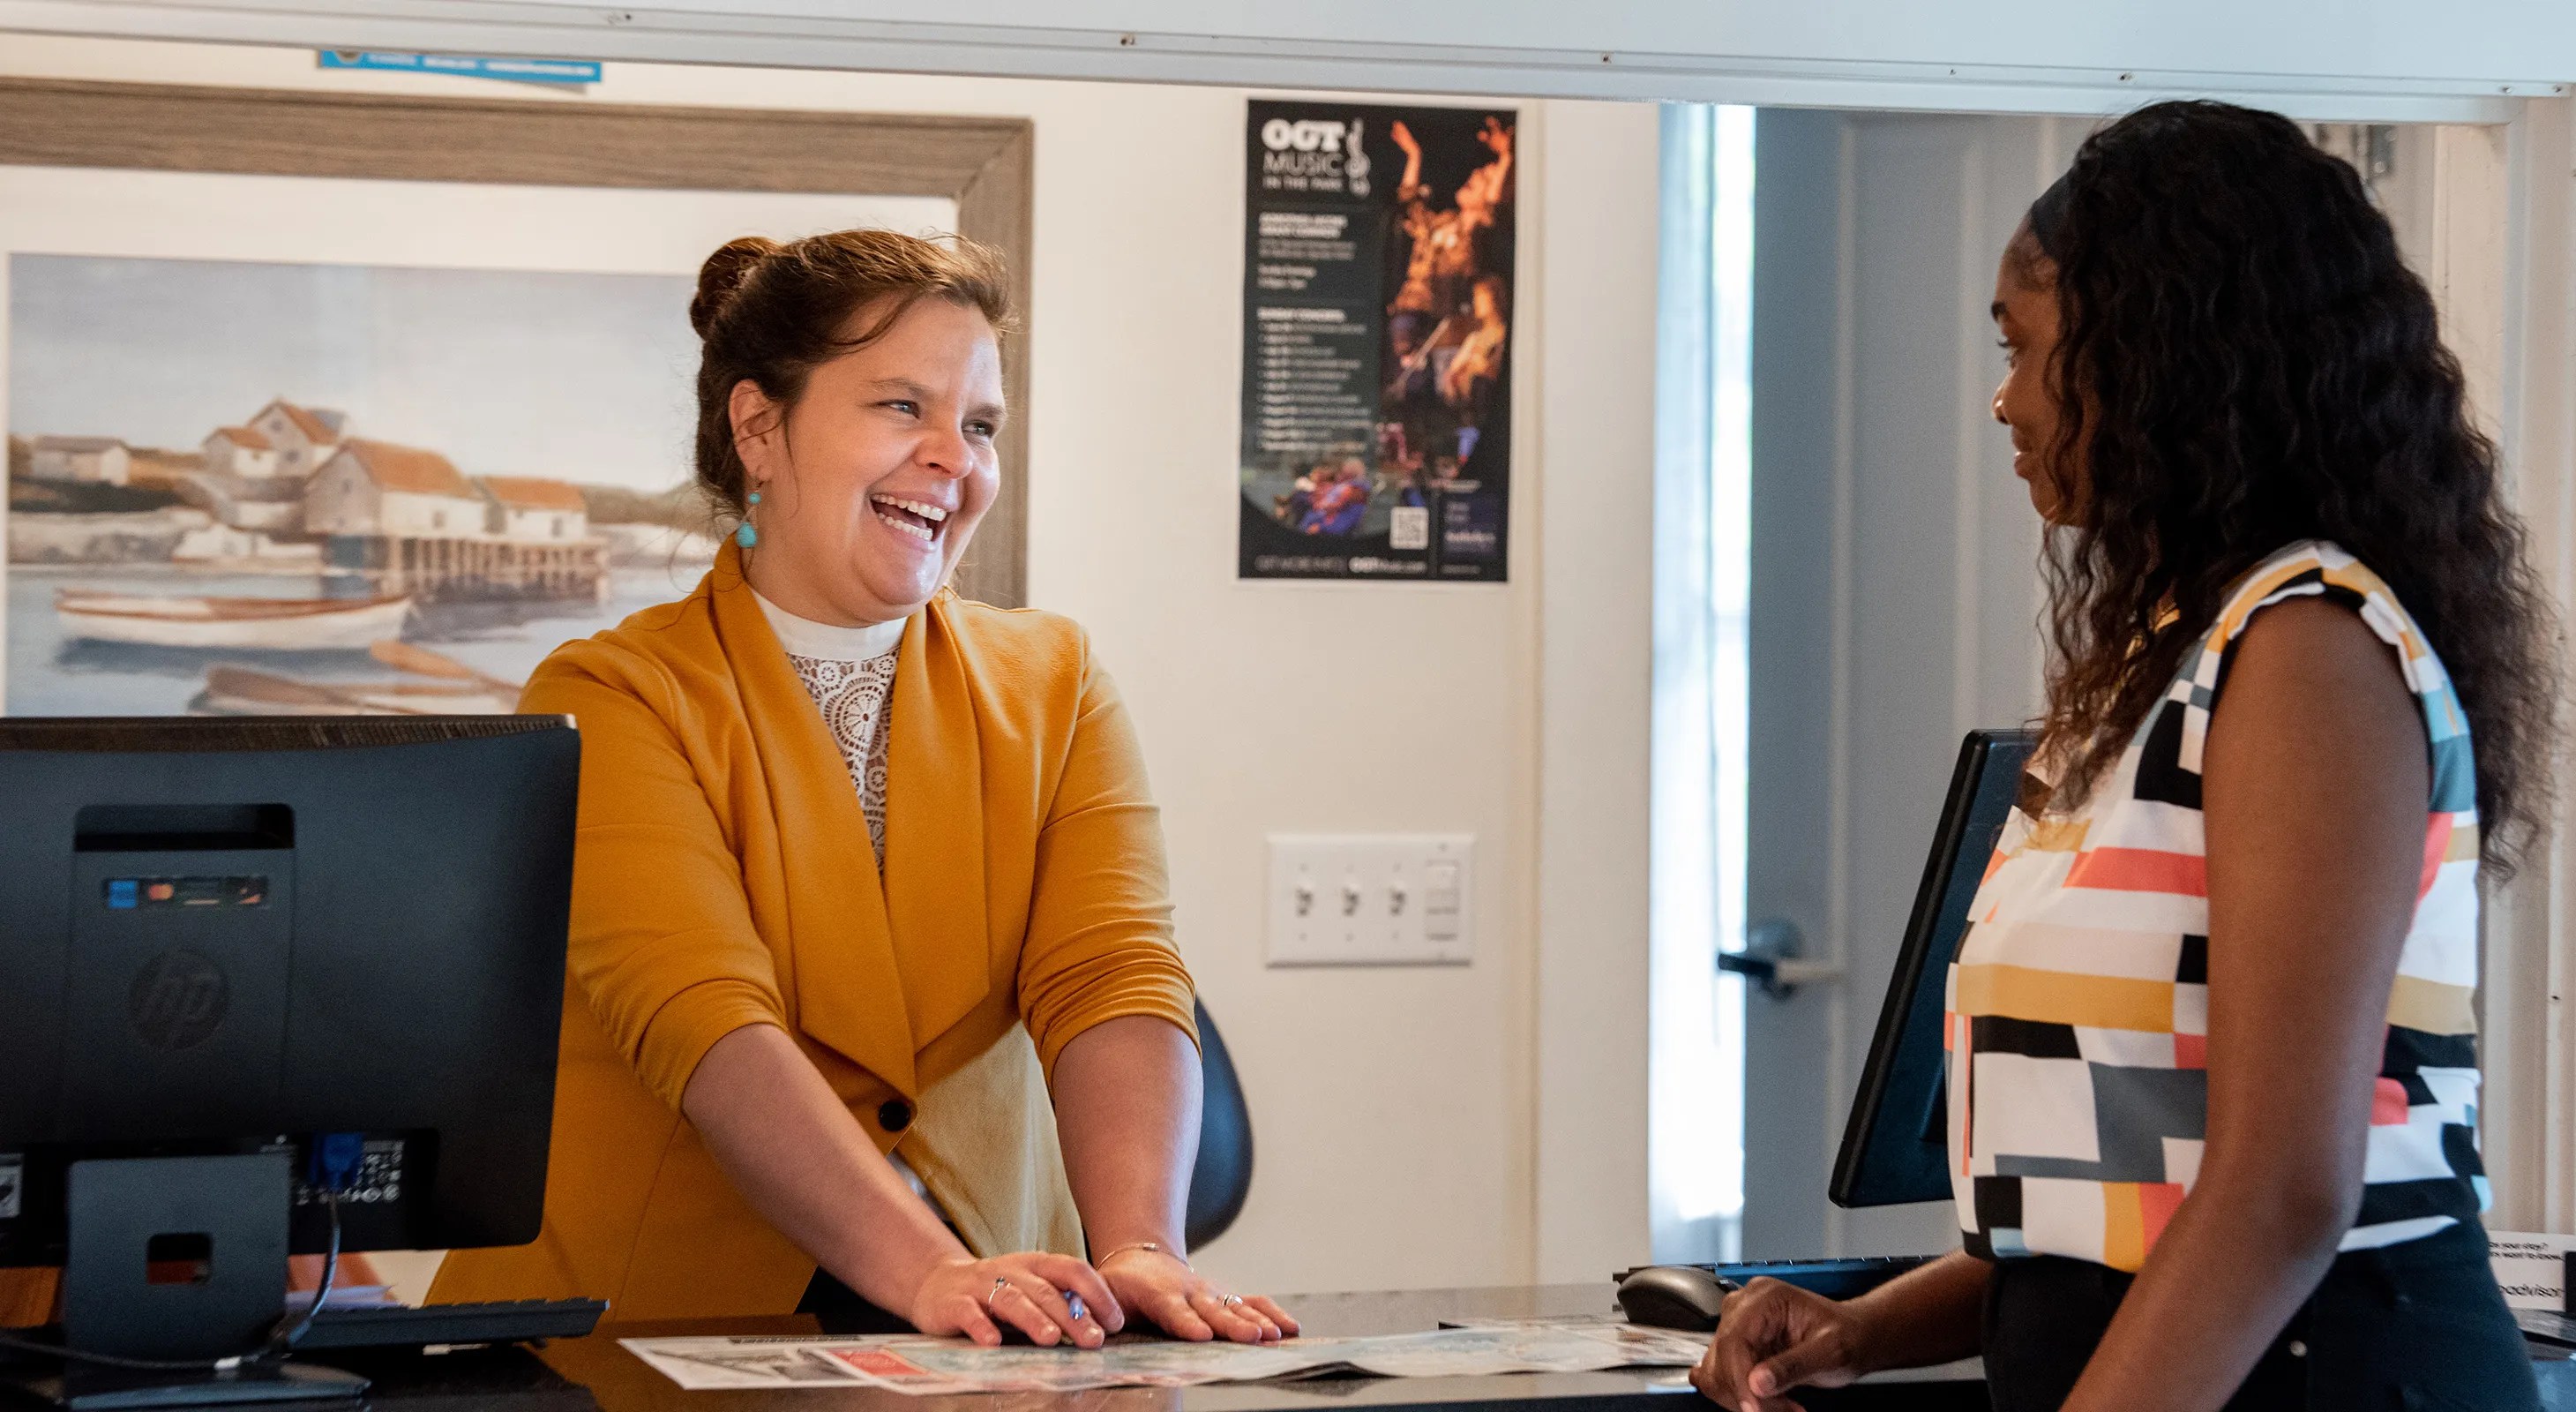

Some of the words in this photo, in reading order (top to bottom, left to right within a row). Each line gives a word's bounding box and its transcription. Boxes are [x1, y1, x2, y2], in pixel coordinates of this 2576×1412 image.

[1262, 118, 1345, 152] OGT
[1262, 151, 1344, 176] MUSIC
[139, 951, 219, 1049] hp
